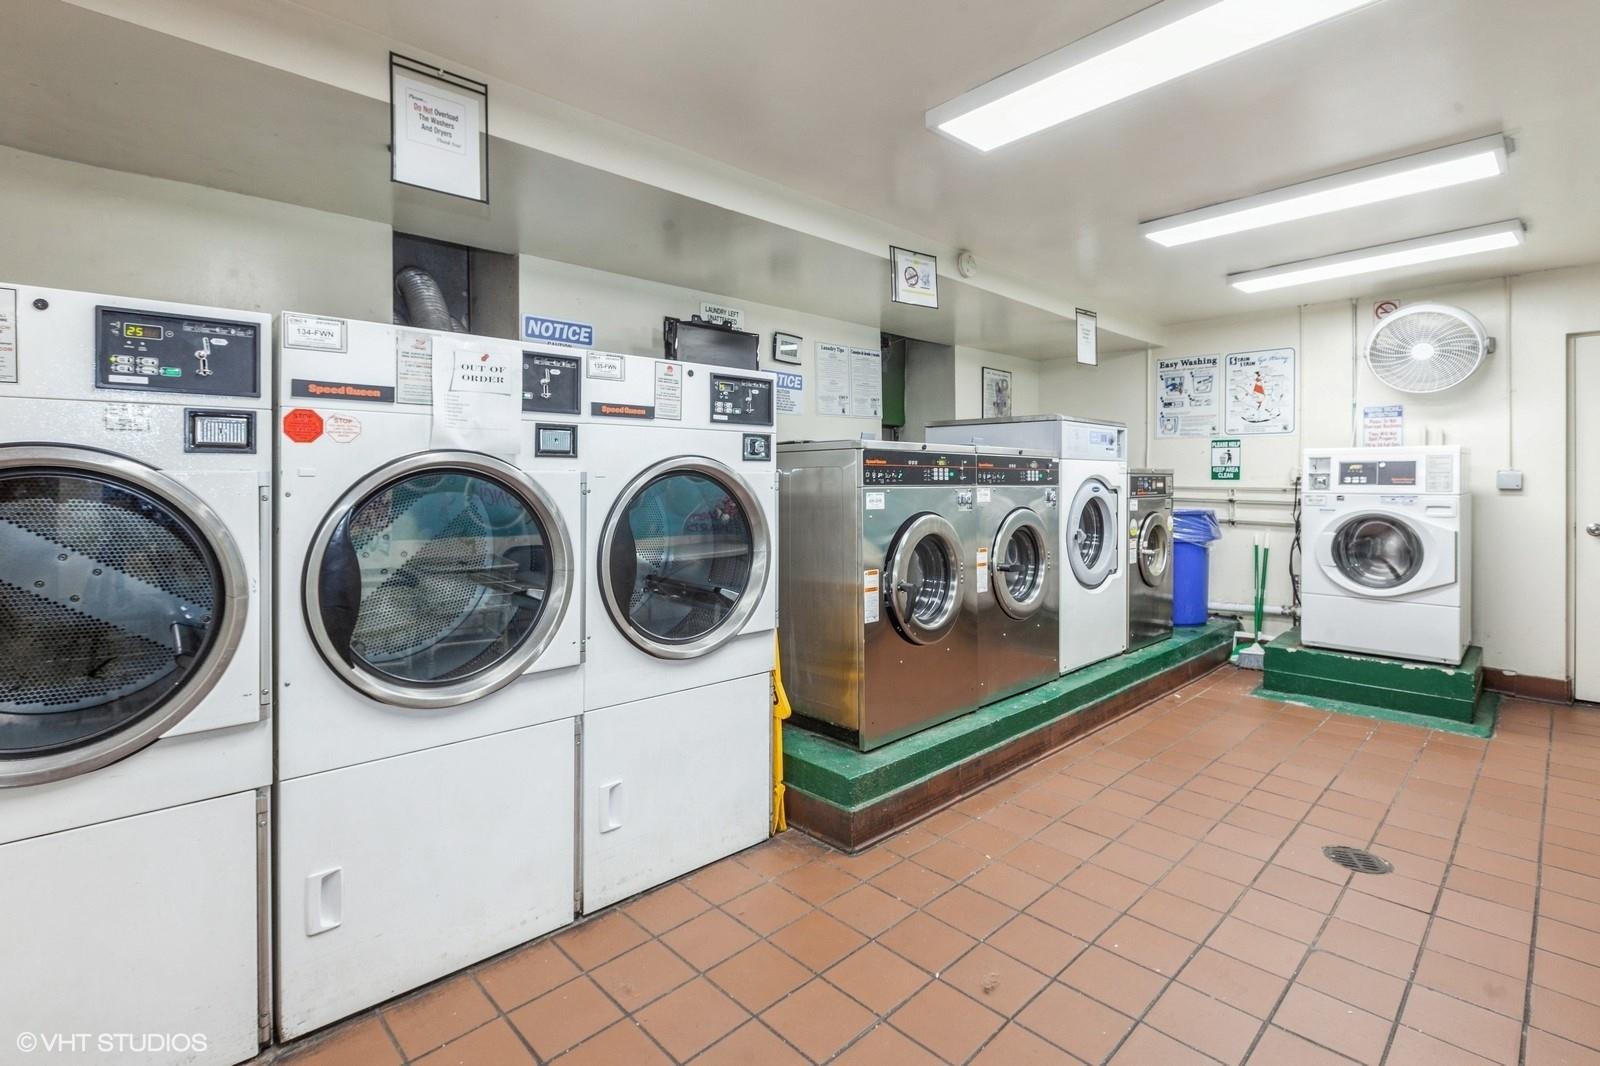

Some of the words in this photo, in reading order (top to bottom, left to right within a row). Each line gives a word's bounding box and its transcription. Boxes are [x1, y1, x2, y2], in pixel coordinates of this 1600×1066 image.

[414, 102, 422, 112] Do
[423, 104, 433, 115] Not
[434, 108, 459, 122] Overload
[418, 113, 430, 123] The
[431, 116, 455, 130] Washers
[421, 123, 433, 133] And
[434, 125, 453, 138] Dryers
[704, 306, 728, 316] LAUNDRY
[728, 310, 739, 318] LEFT
[126, 326, 144, 336] 25
[297, 328, 334, 338] 134-FWN
[528, 319, 592, 342] NOTICE
[462, 364, 486, 372] OUT
[1160, 360, 1178, 370] Easy
[1180, 357, 1218, 368] Washing
[462, 374, 504, 383] ORDER
[778, 374, 802, 388] TICE
[308, 384, 345, 395] Speed
[346, 386, 381, 397] Queen
[602, 405, 625, 414] Speed
